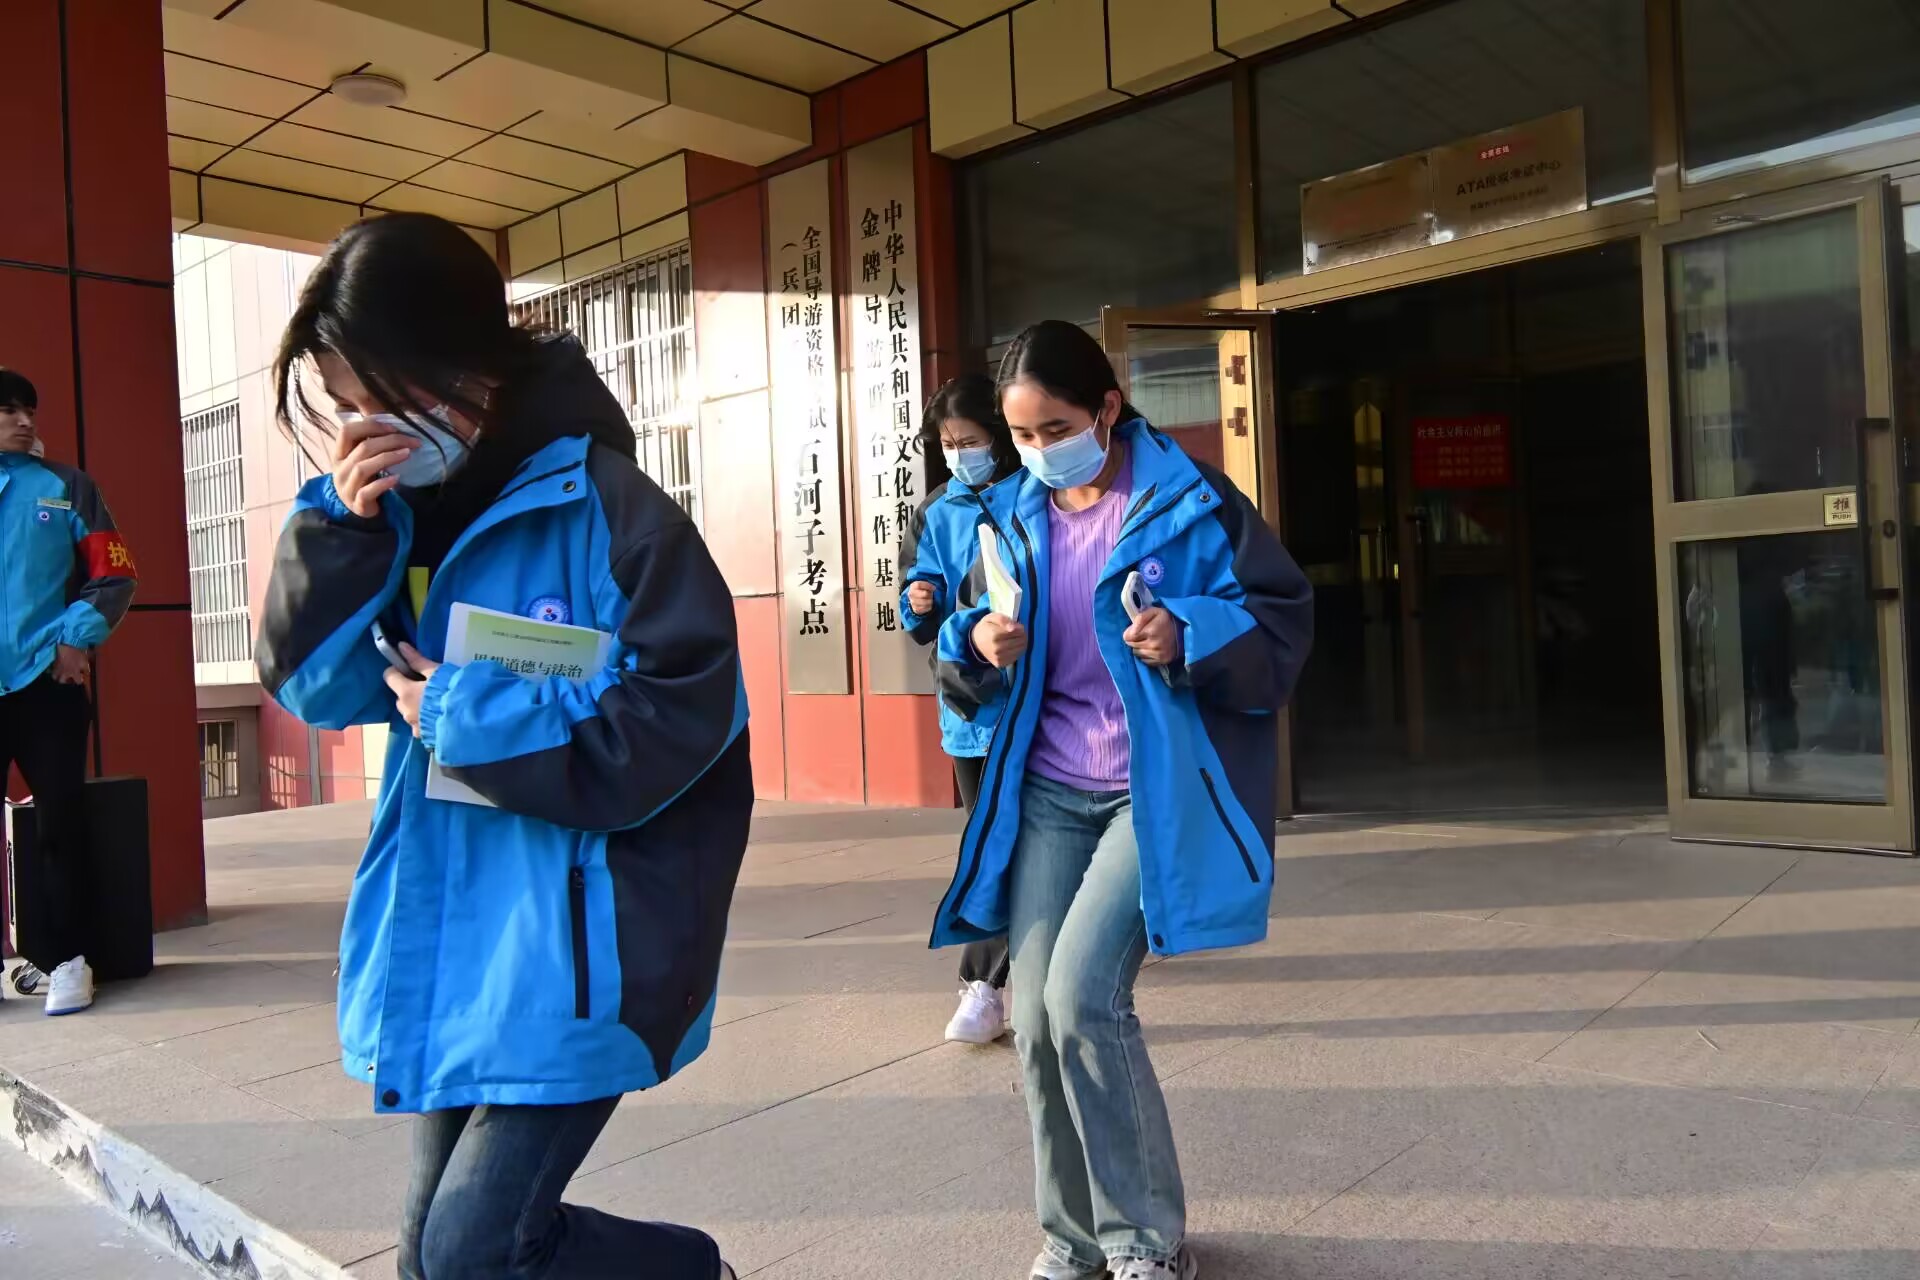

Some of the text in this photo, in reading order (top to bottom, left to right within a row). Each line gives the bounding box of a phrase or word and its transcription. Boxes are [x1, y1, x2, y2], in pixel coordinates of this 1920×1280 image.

[781, 241, 800, 344] （兵团
[793, 226, 829, 636] 全国导游资格试石河子考点
[884, 200, 915, 632] 中华人民共和国文化和
[1832, 513, 1852, 521] PUSH
[1833, 497, 1850, 512] 推
